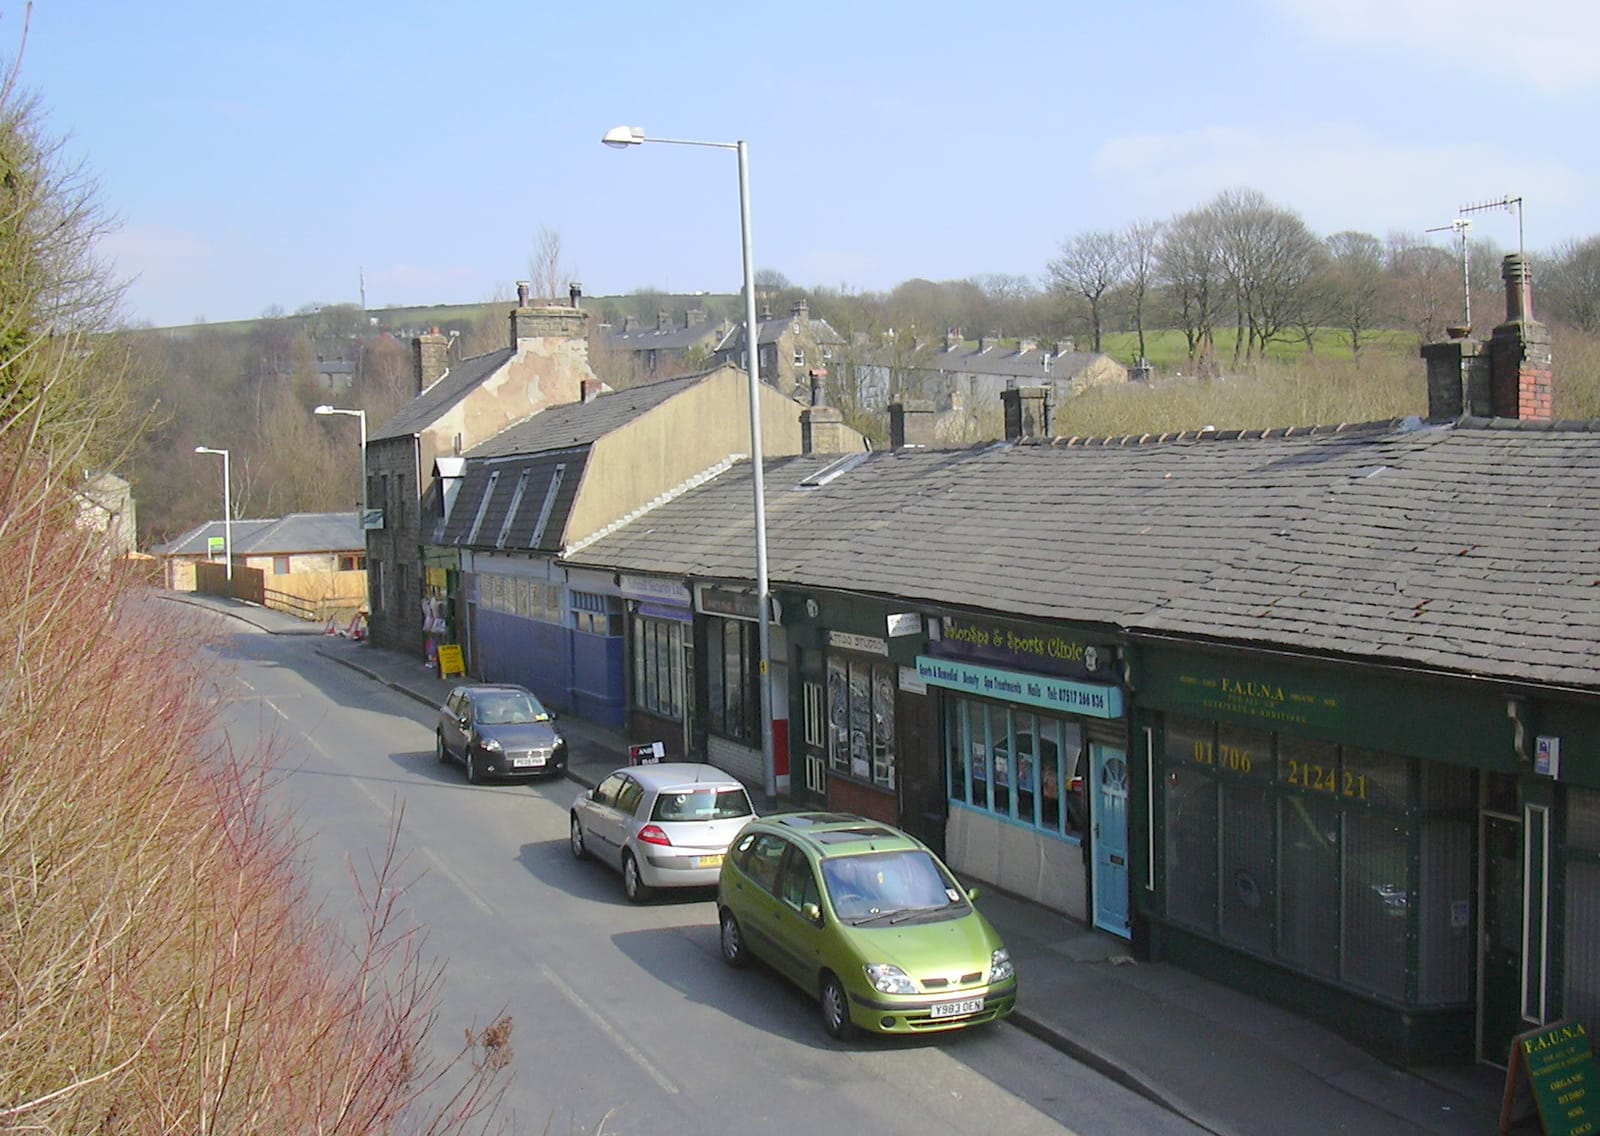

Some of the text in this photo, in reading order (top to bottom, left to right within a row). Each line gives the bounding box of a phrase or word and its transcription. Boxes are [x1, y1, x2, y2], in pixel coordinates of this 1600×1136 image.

[992, 628, 1003, 646] &
[1006, 630, 1044, 655] Sports
[1047, 637, 1083, 661] Clinic
[936, 1003, 961, 1015] Y983
